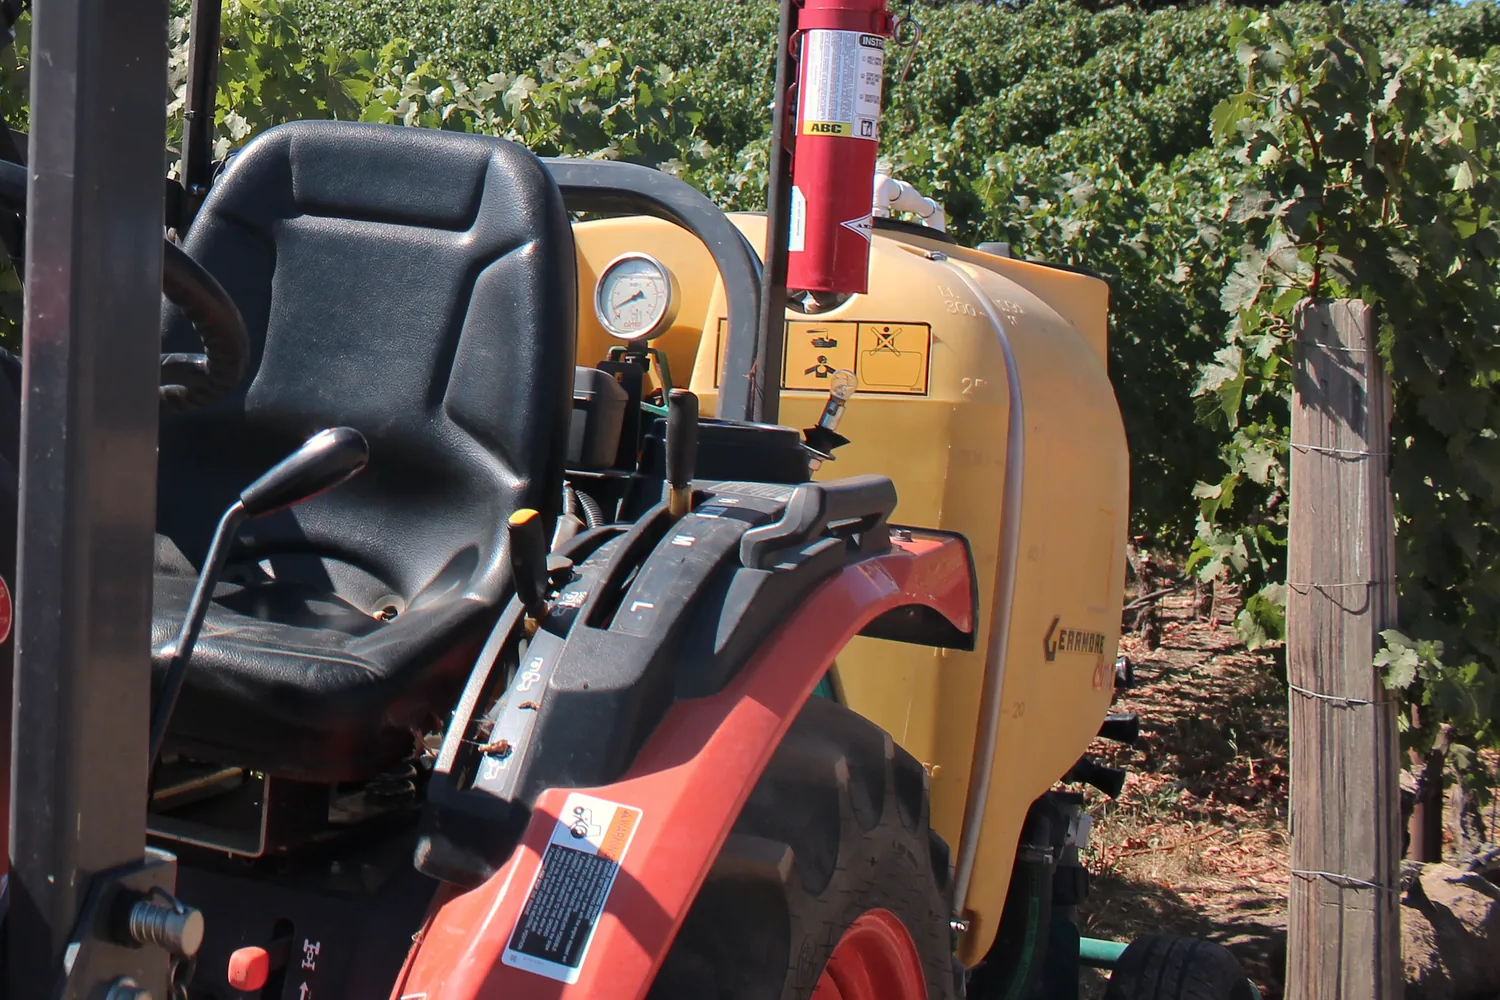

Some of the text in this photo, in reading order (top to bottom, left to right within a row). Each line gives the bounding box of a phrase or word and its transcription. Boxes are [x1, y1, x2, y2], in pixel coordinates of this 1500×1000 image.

[811, 123, 842, 134] ABC
[630, 600, 654, 612] L
[1043, 615, 1105, 662] GEARMORE
[606, 819, 630, 858] WARNING
